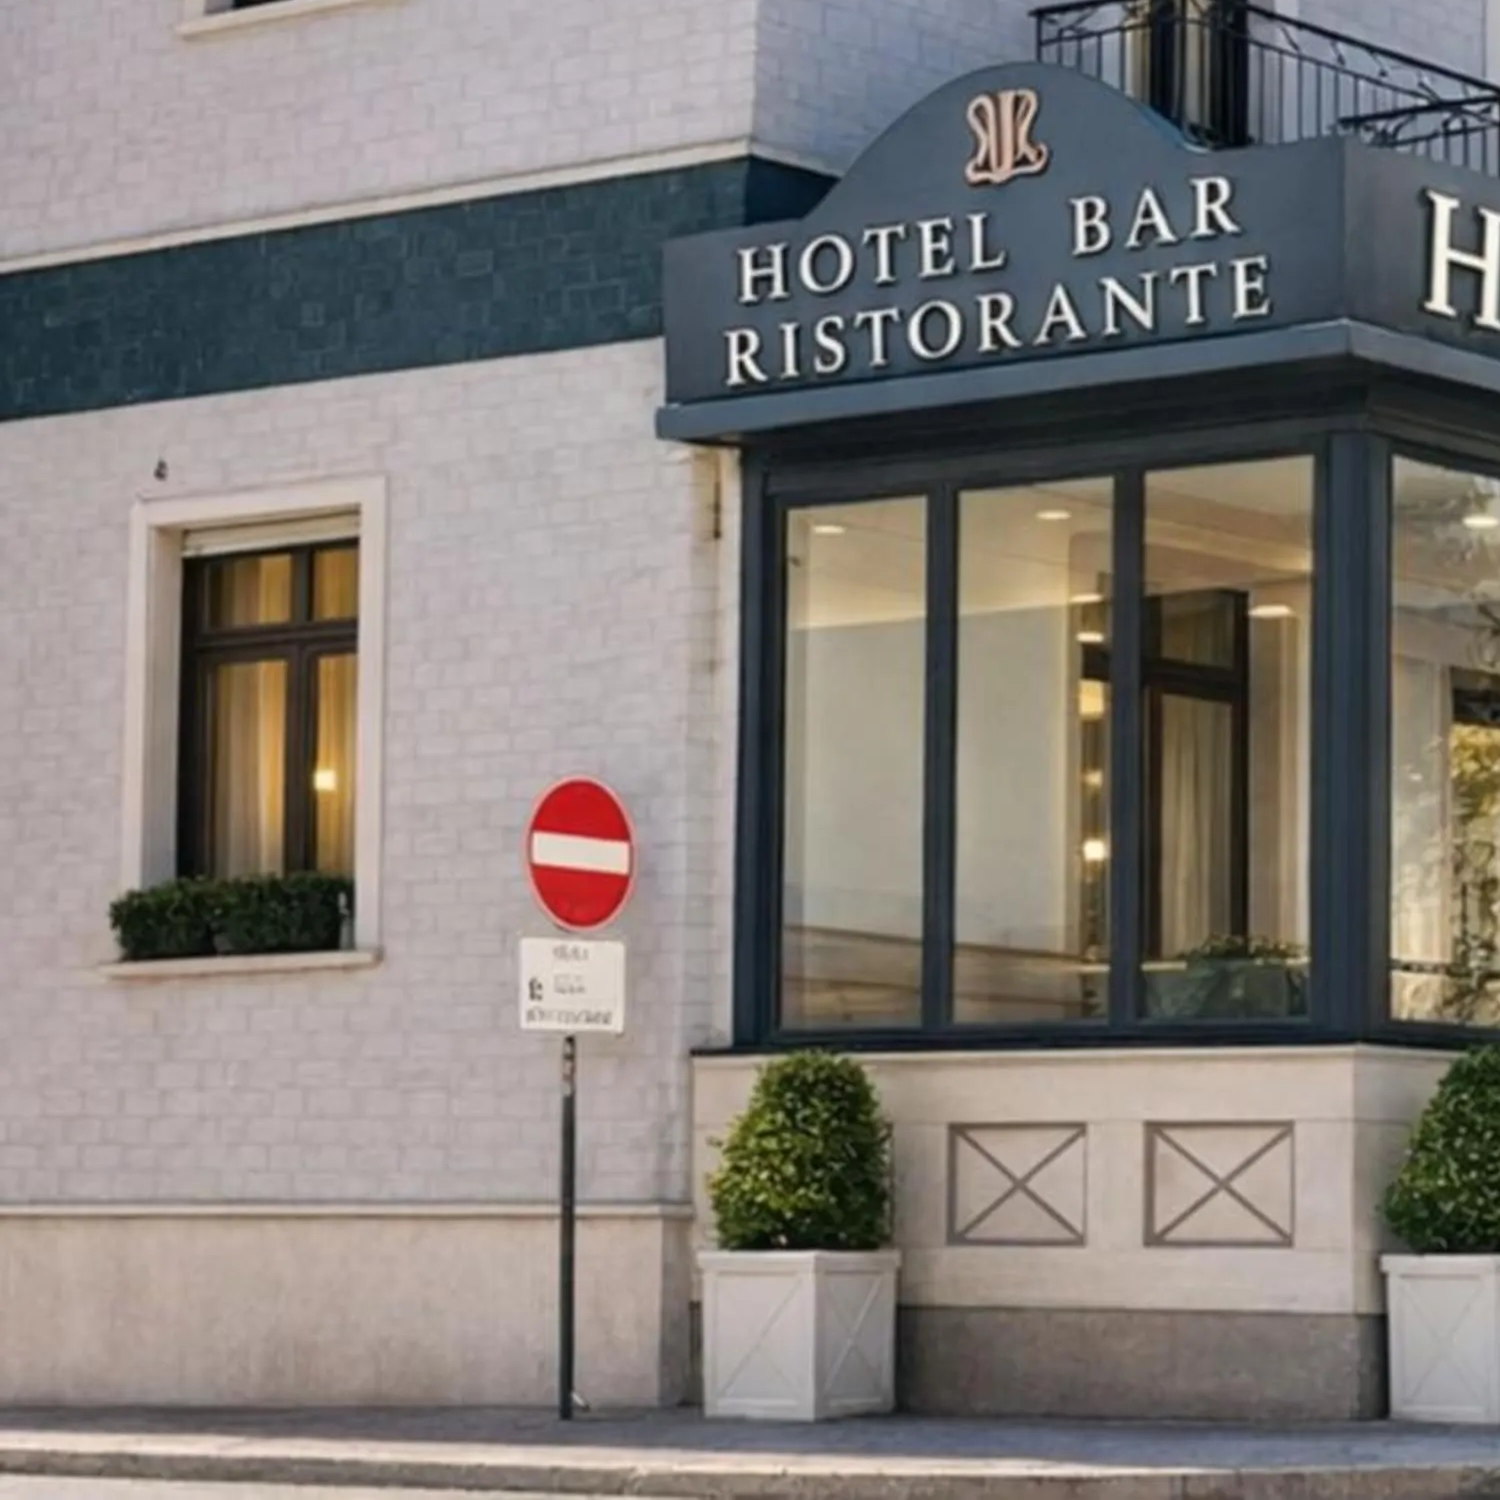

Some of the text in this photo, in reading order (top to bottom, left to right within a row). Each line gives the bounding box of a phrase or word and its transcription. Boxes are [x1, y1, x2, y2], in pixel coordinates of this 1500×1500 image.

[737, 176, 1240, 303] HOTEL BAR
[724, 255, 1272, 386] RISTORANTE
